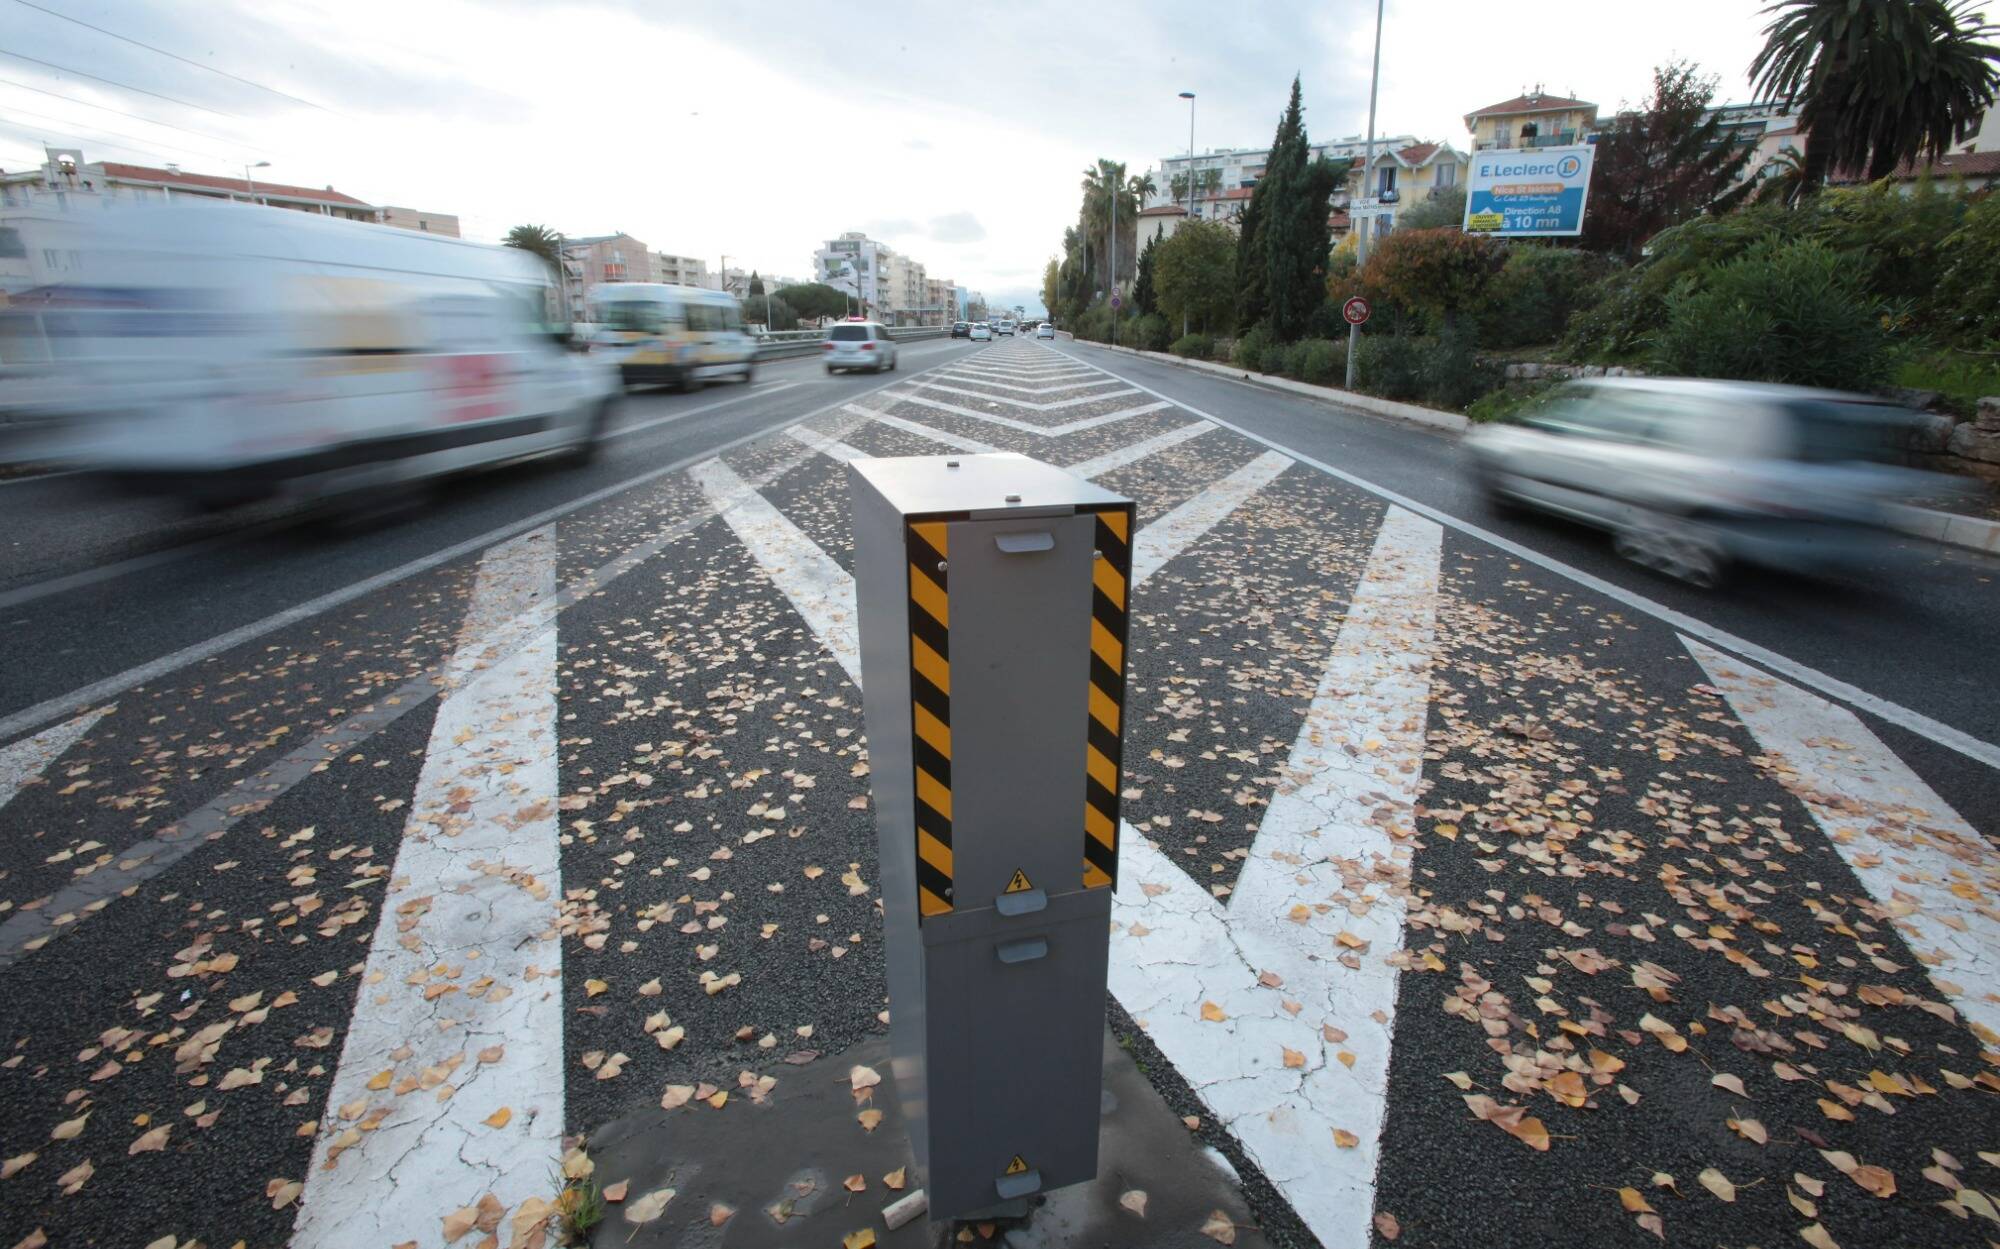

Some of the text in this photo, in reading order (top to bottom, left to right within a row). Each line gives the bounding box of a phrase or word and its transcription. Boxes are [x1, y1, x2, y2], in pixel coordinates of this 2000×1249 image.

[1480, 163, 1554, 177] E.Leclerc
[1504, 205, 1562, 216] Direction A8
[1502, 215, 1560, 229] à 10 mn
